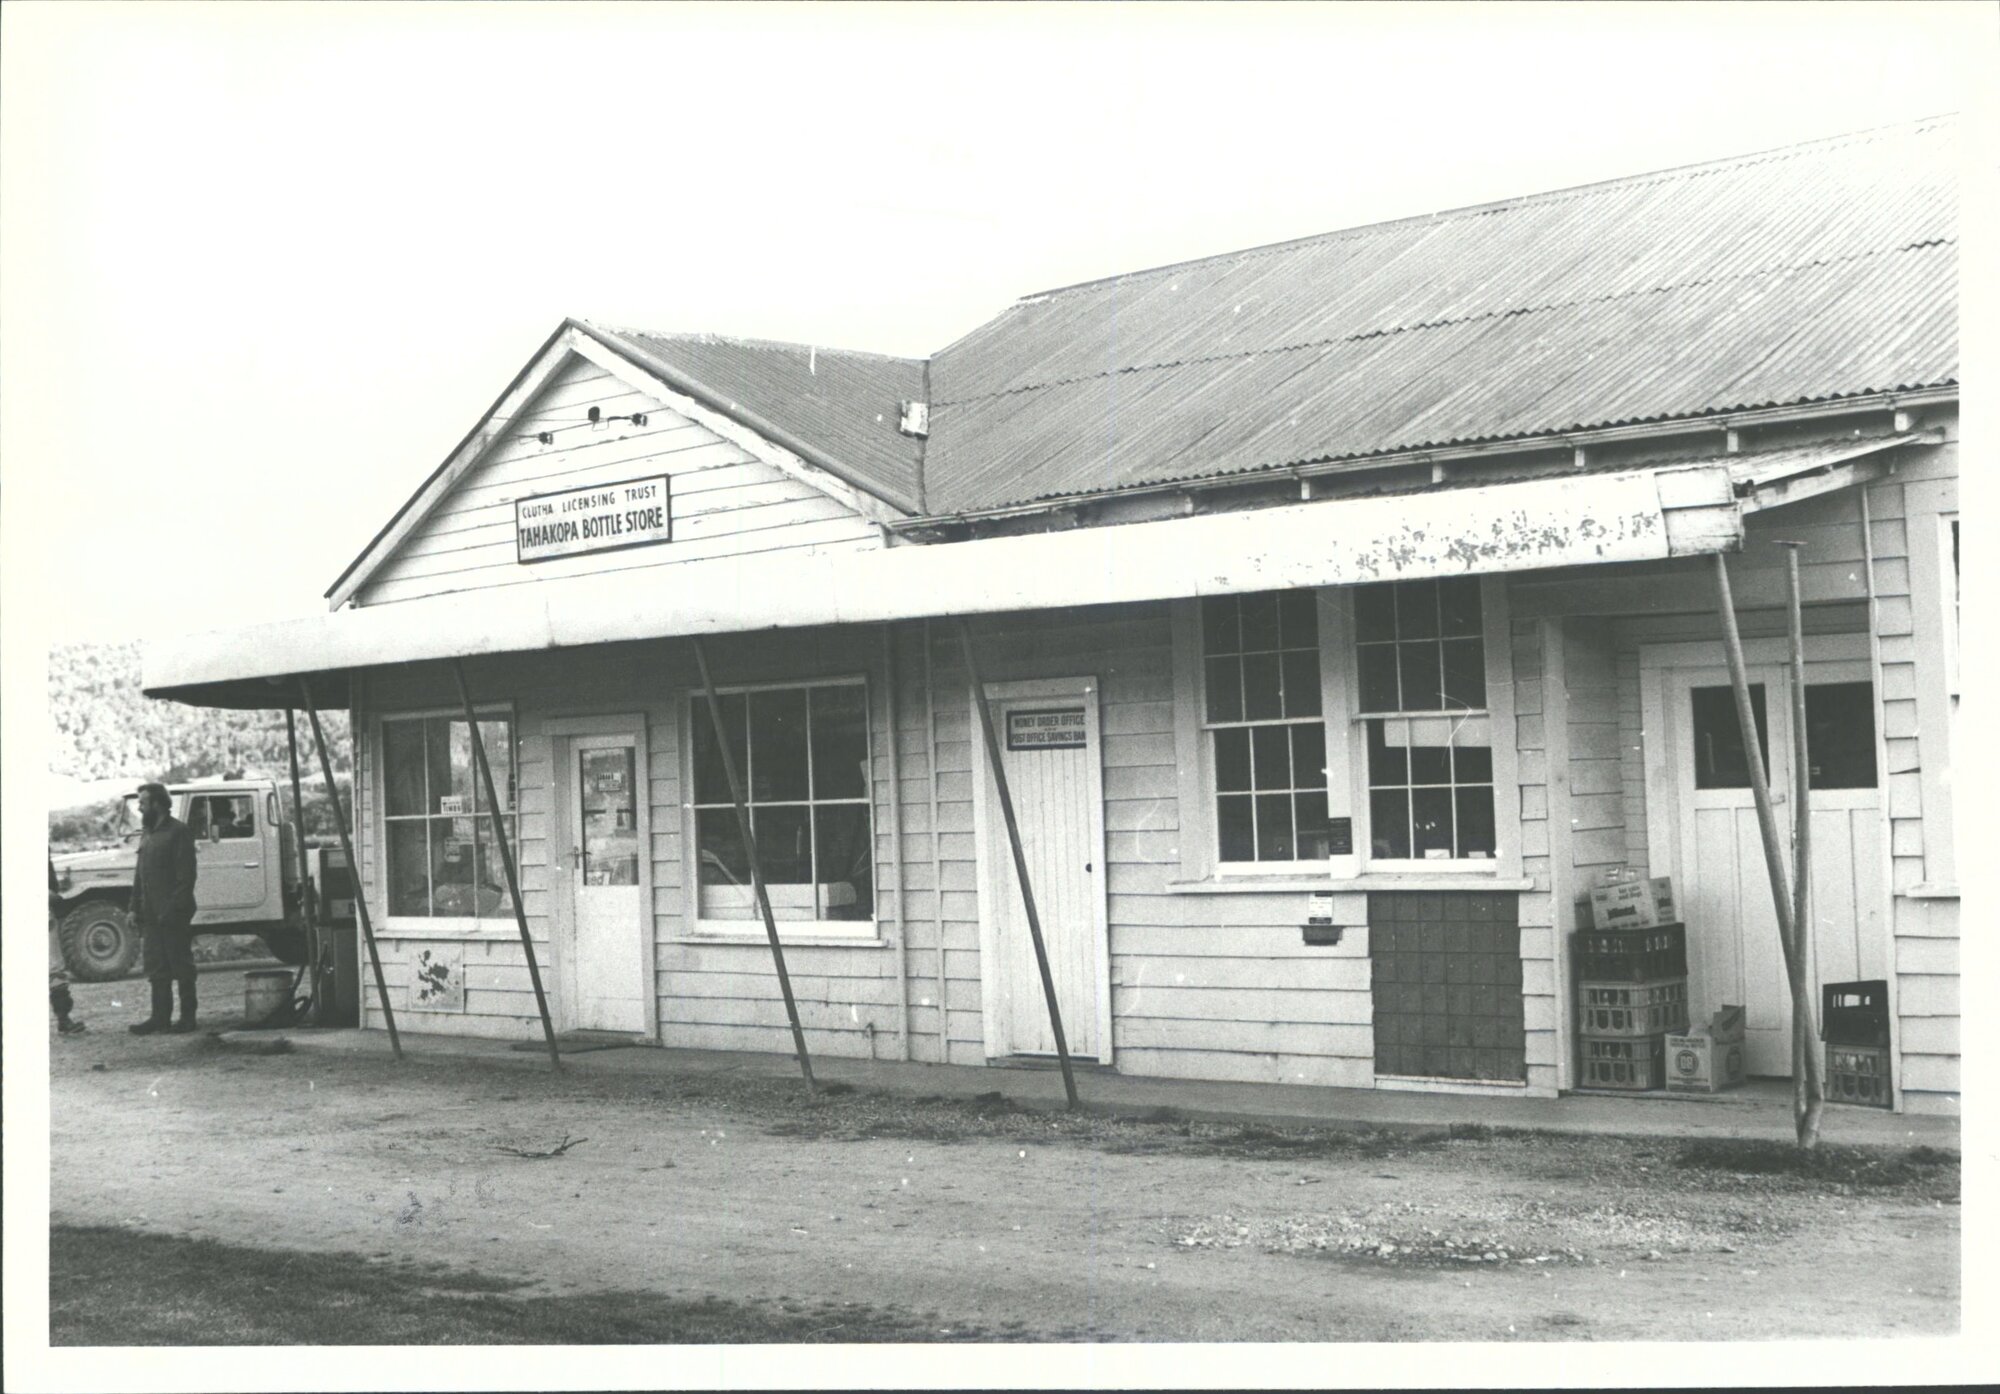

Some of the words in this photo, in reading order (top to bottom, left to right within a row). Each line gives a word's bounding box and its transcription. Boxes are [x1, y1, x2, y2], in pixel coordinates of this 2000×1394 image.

[522, 504, 553, 519] CLUTHA
[562, 493, 616, 512] LICENSING
[625, 485, 657, 501] TRUST
[520, 521, 579, 549] TAHAKOPA
[582, 514, 622, 539] BOTTLE
[626, 507, 663, 532] STORE
[1061, 714, 1086, 726] OFFICE
